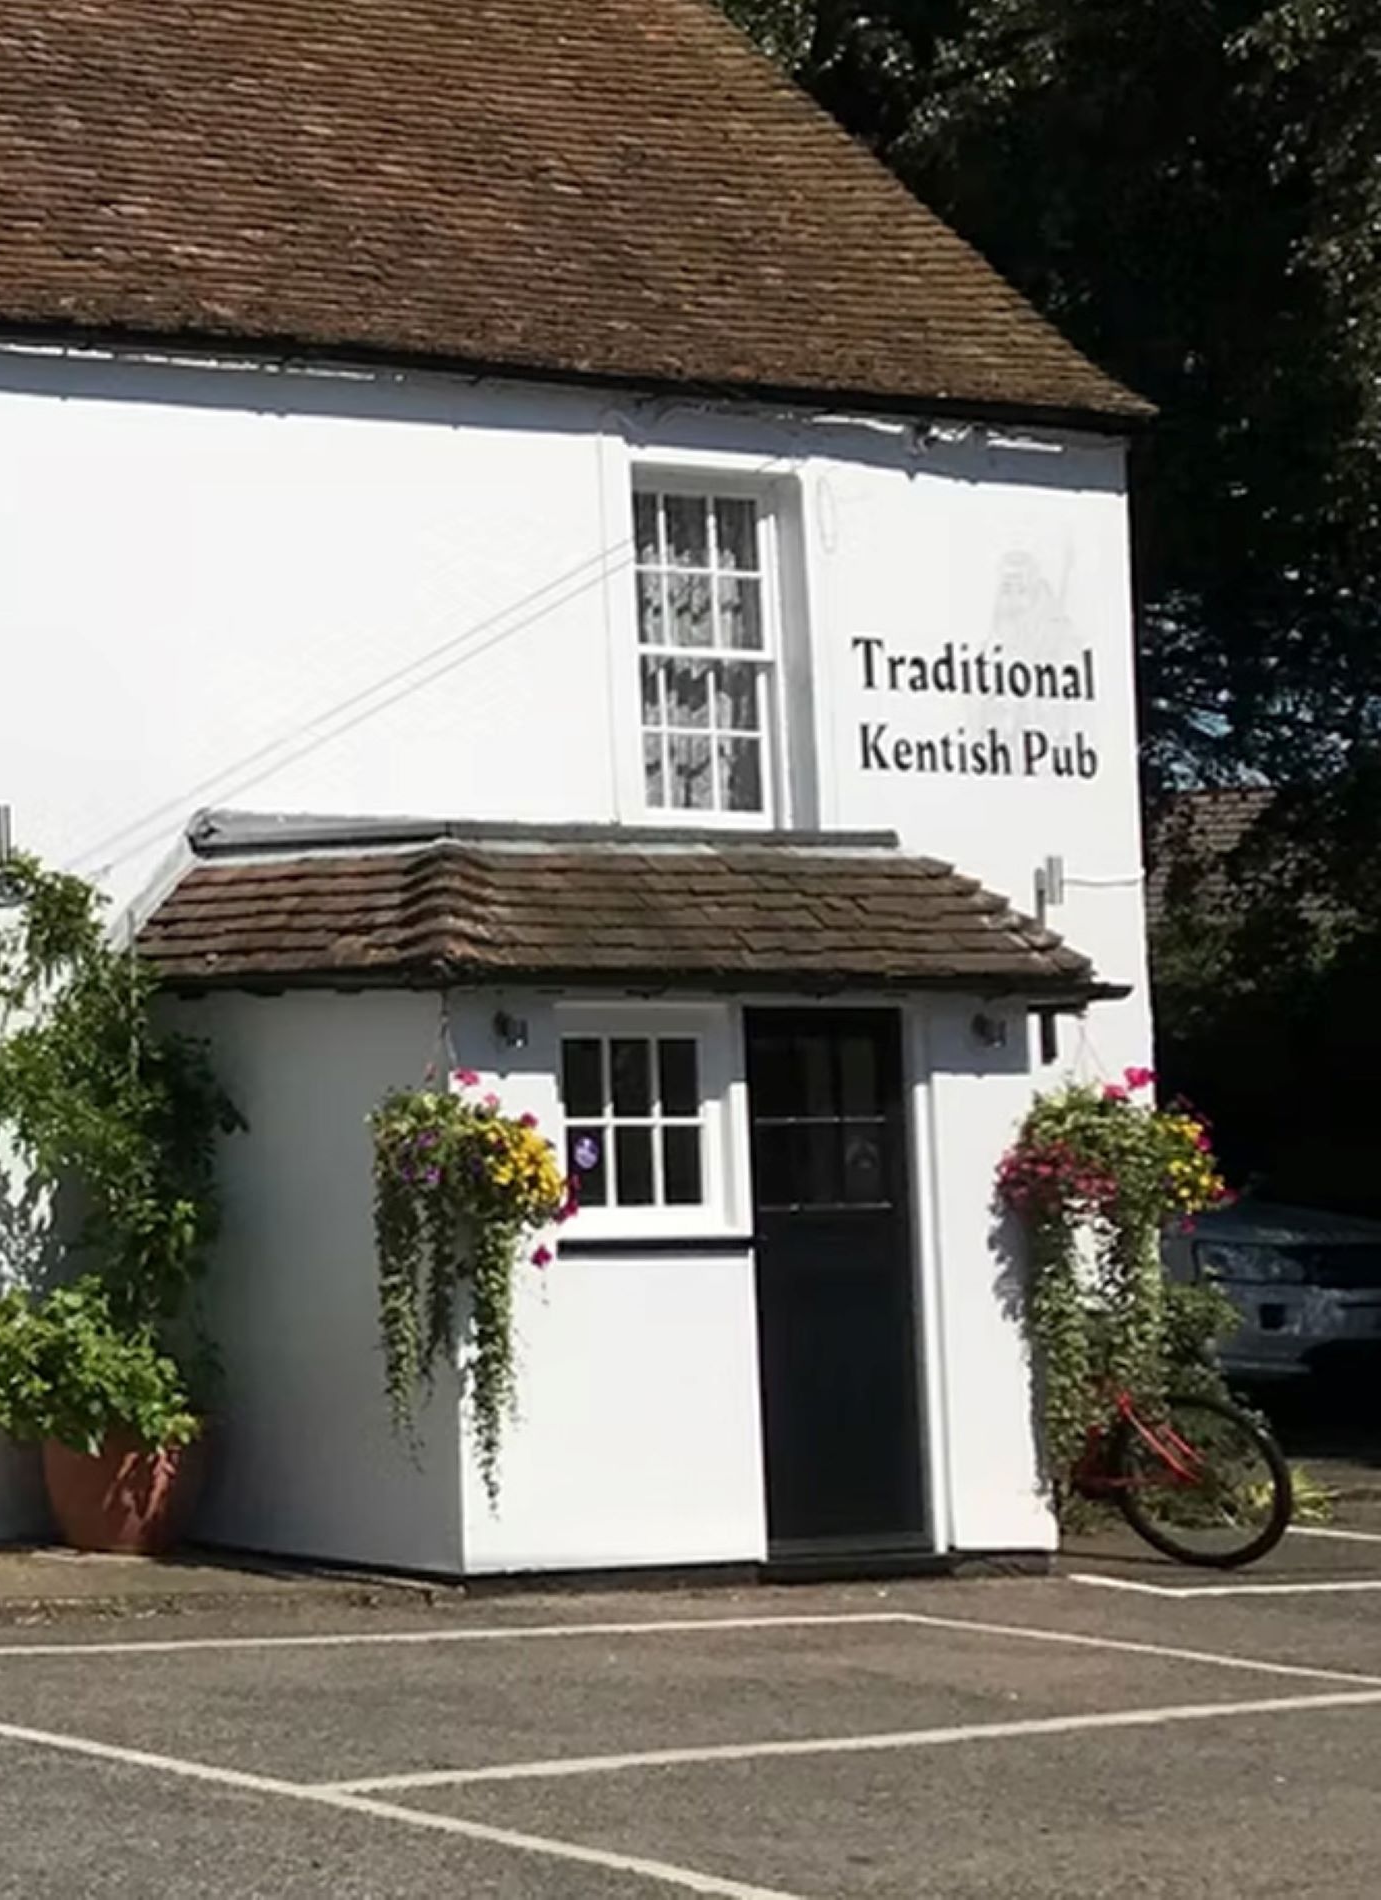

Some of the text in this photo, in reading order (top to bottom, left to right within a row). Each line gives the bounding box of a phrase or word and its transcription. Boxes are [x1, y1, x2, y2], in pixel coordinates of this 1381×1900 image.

[851, 636, 1097, 701] Traditional
[859, 721, 1099, 779] Kentish Pub
